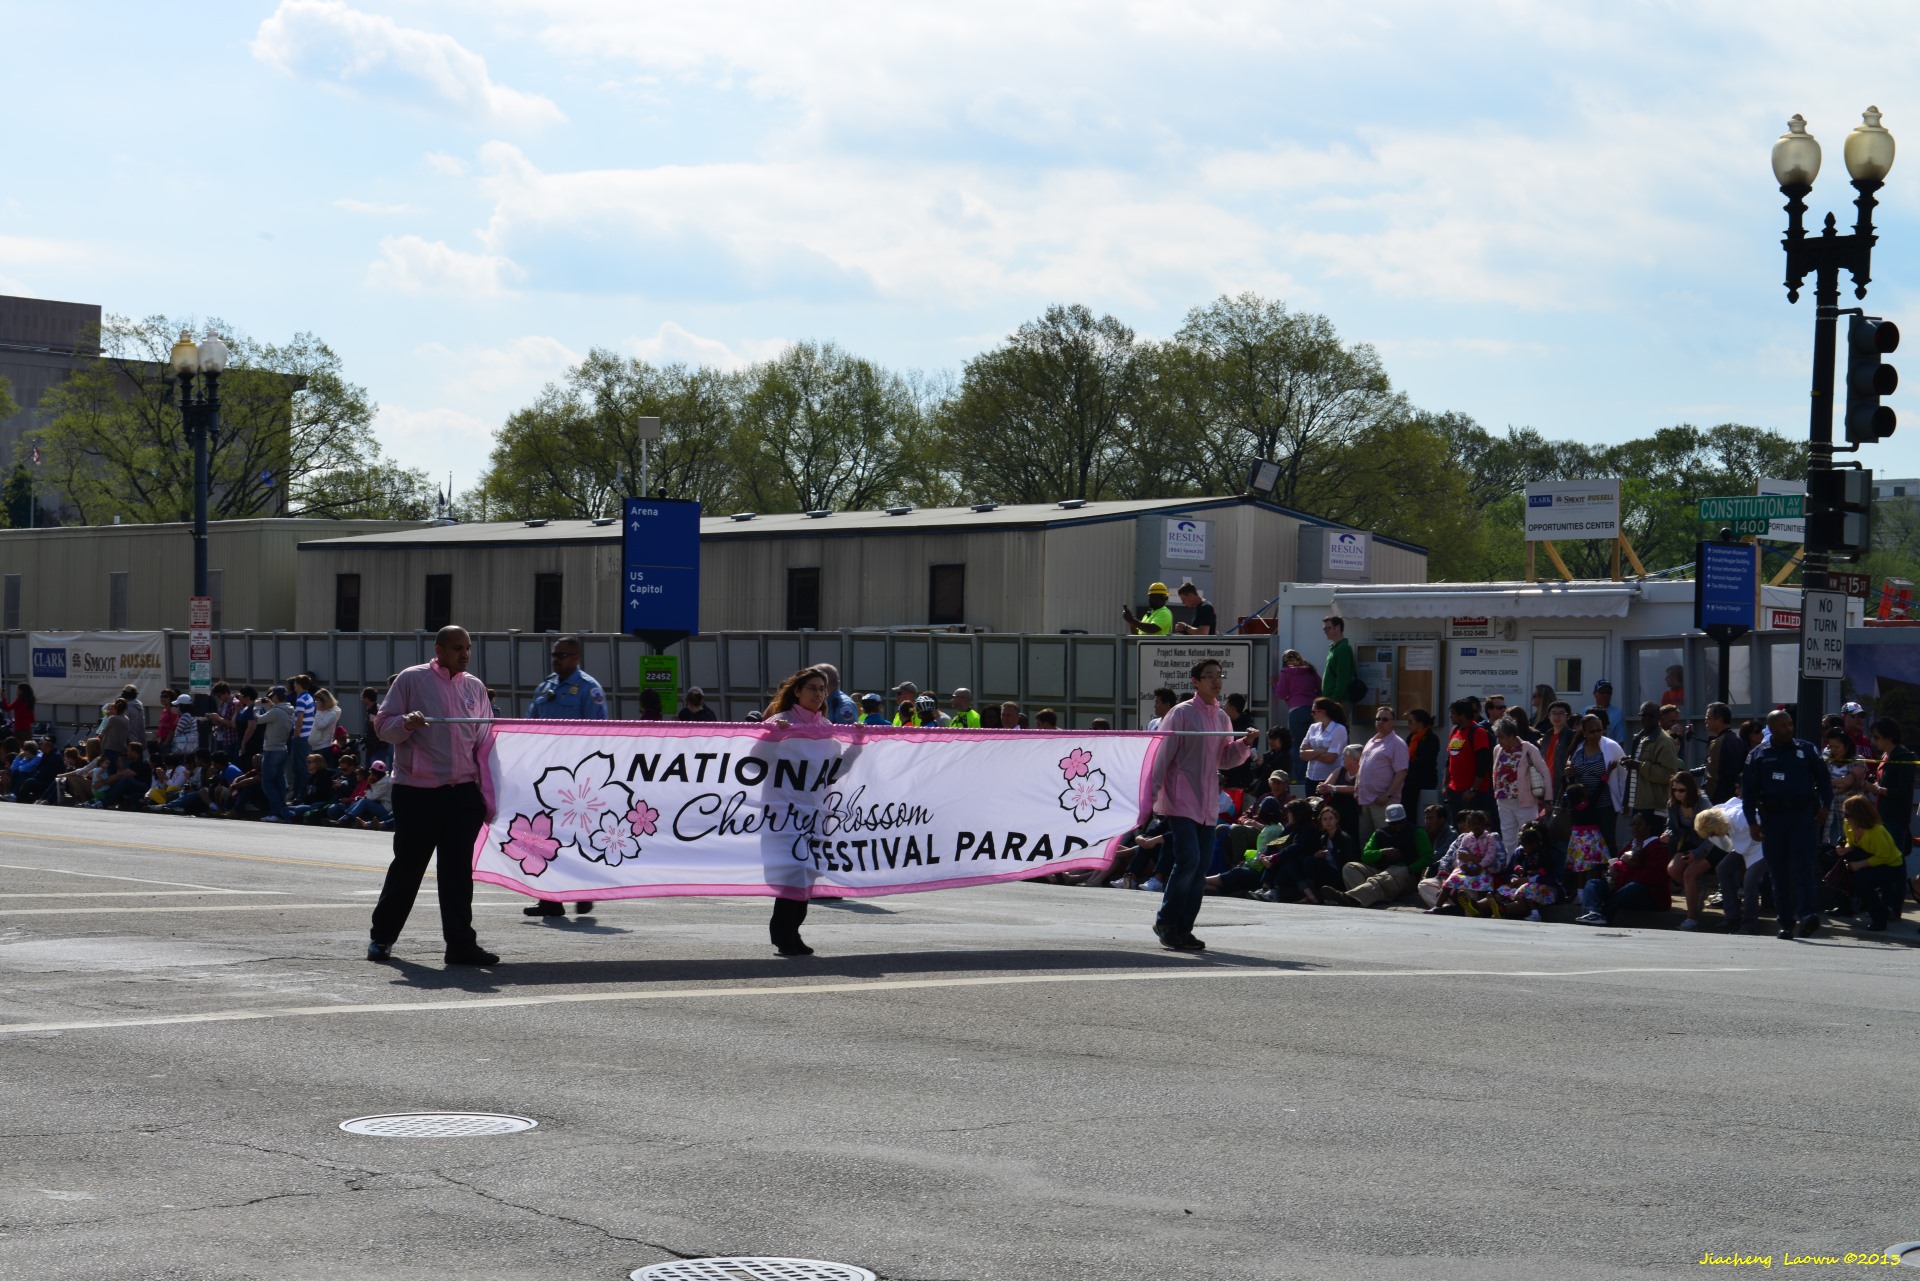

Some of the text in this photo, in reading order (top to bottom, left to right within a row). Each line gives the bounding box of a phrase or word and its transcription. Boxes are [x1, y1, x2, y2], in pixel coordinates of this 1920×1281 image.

[631, 506, 659, 516] Arena
[1701, 497, 1800, 519] CONSTITUTION AV
[1786, 507, 1800, 516] NW
[1528, 521, 1615, 532] OPPORTUNITIES CENTER
[1735, 520, 1765, 533] 1400
[1169, 532, 1204, 543] RESUN
[1331, 545, 1363, 554] RESUN
[630, 571, 644, 581] US
[630, 584, 662, 595] Capitol
[1848, 577, 1859, 593] 15
[1860, 581, 1867, 591] ST
[1819, 599, 1833, 613] NO
[1774, 613, 1801, 626] ALLIED
[1814, 618, 1837, 633] TURN
[1824, 638, 1842, 652] RED
[1157, 648, 1173, 657] Project
[1188, 648, 1206, 656] National
[1207, 648, 1224, 656] Museum
[34, 652, 65, 667] CLARK
[120, 653, 161, 669] RUSSELL
[1153, 659, 1169, 668] African
[1170, 659, 1190, 668] American
[1806, 657, 1842, 672] 7AM-7PM
[646, 672, 672, 681] 22452
[1160, 671, 1176, 680] Project
[1177, 671, 1188, 679] Start
[1164, 682, 1180, 691] Project
[1181, 682, 1189, 690] End
[626, 752, 844, 792] NATIONAL
[673, 785, 935, 861] Cherry Blossom
[810, 831, 1113, 872] FESTIVAL PARAD
